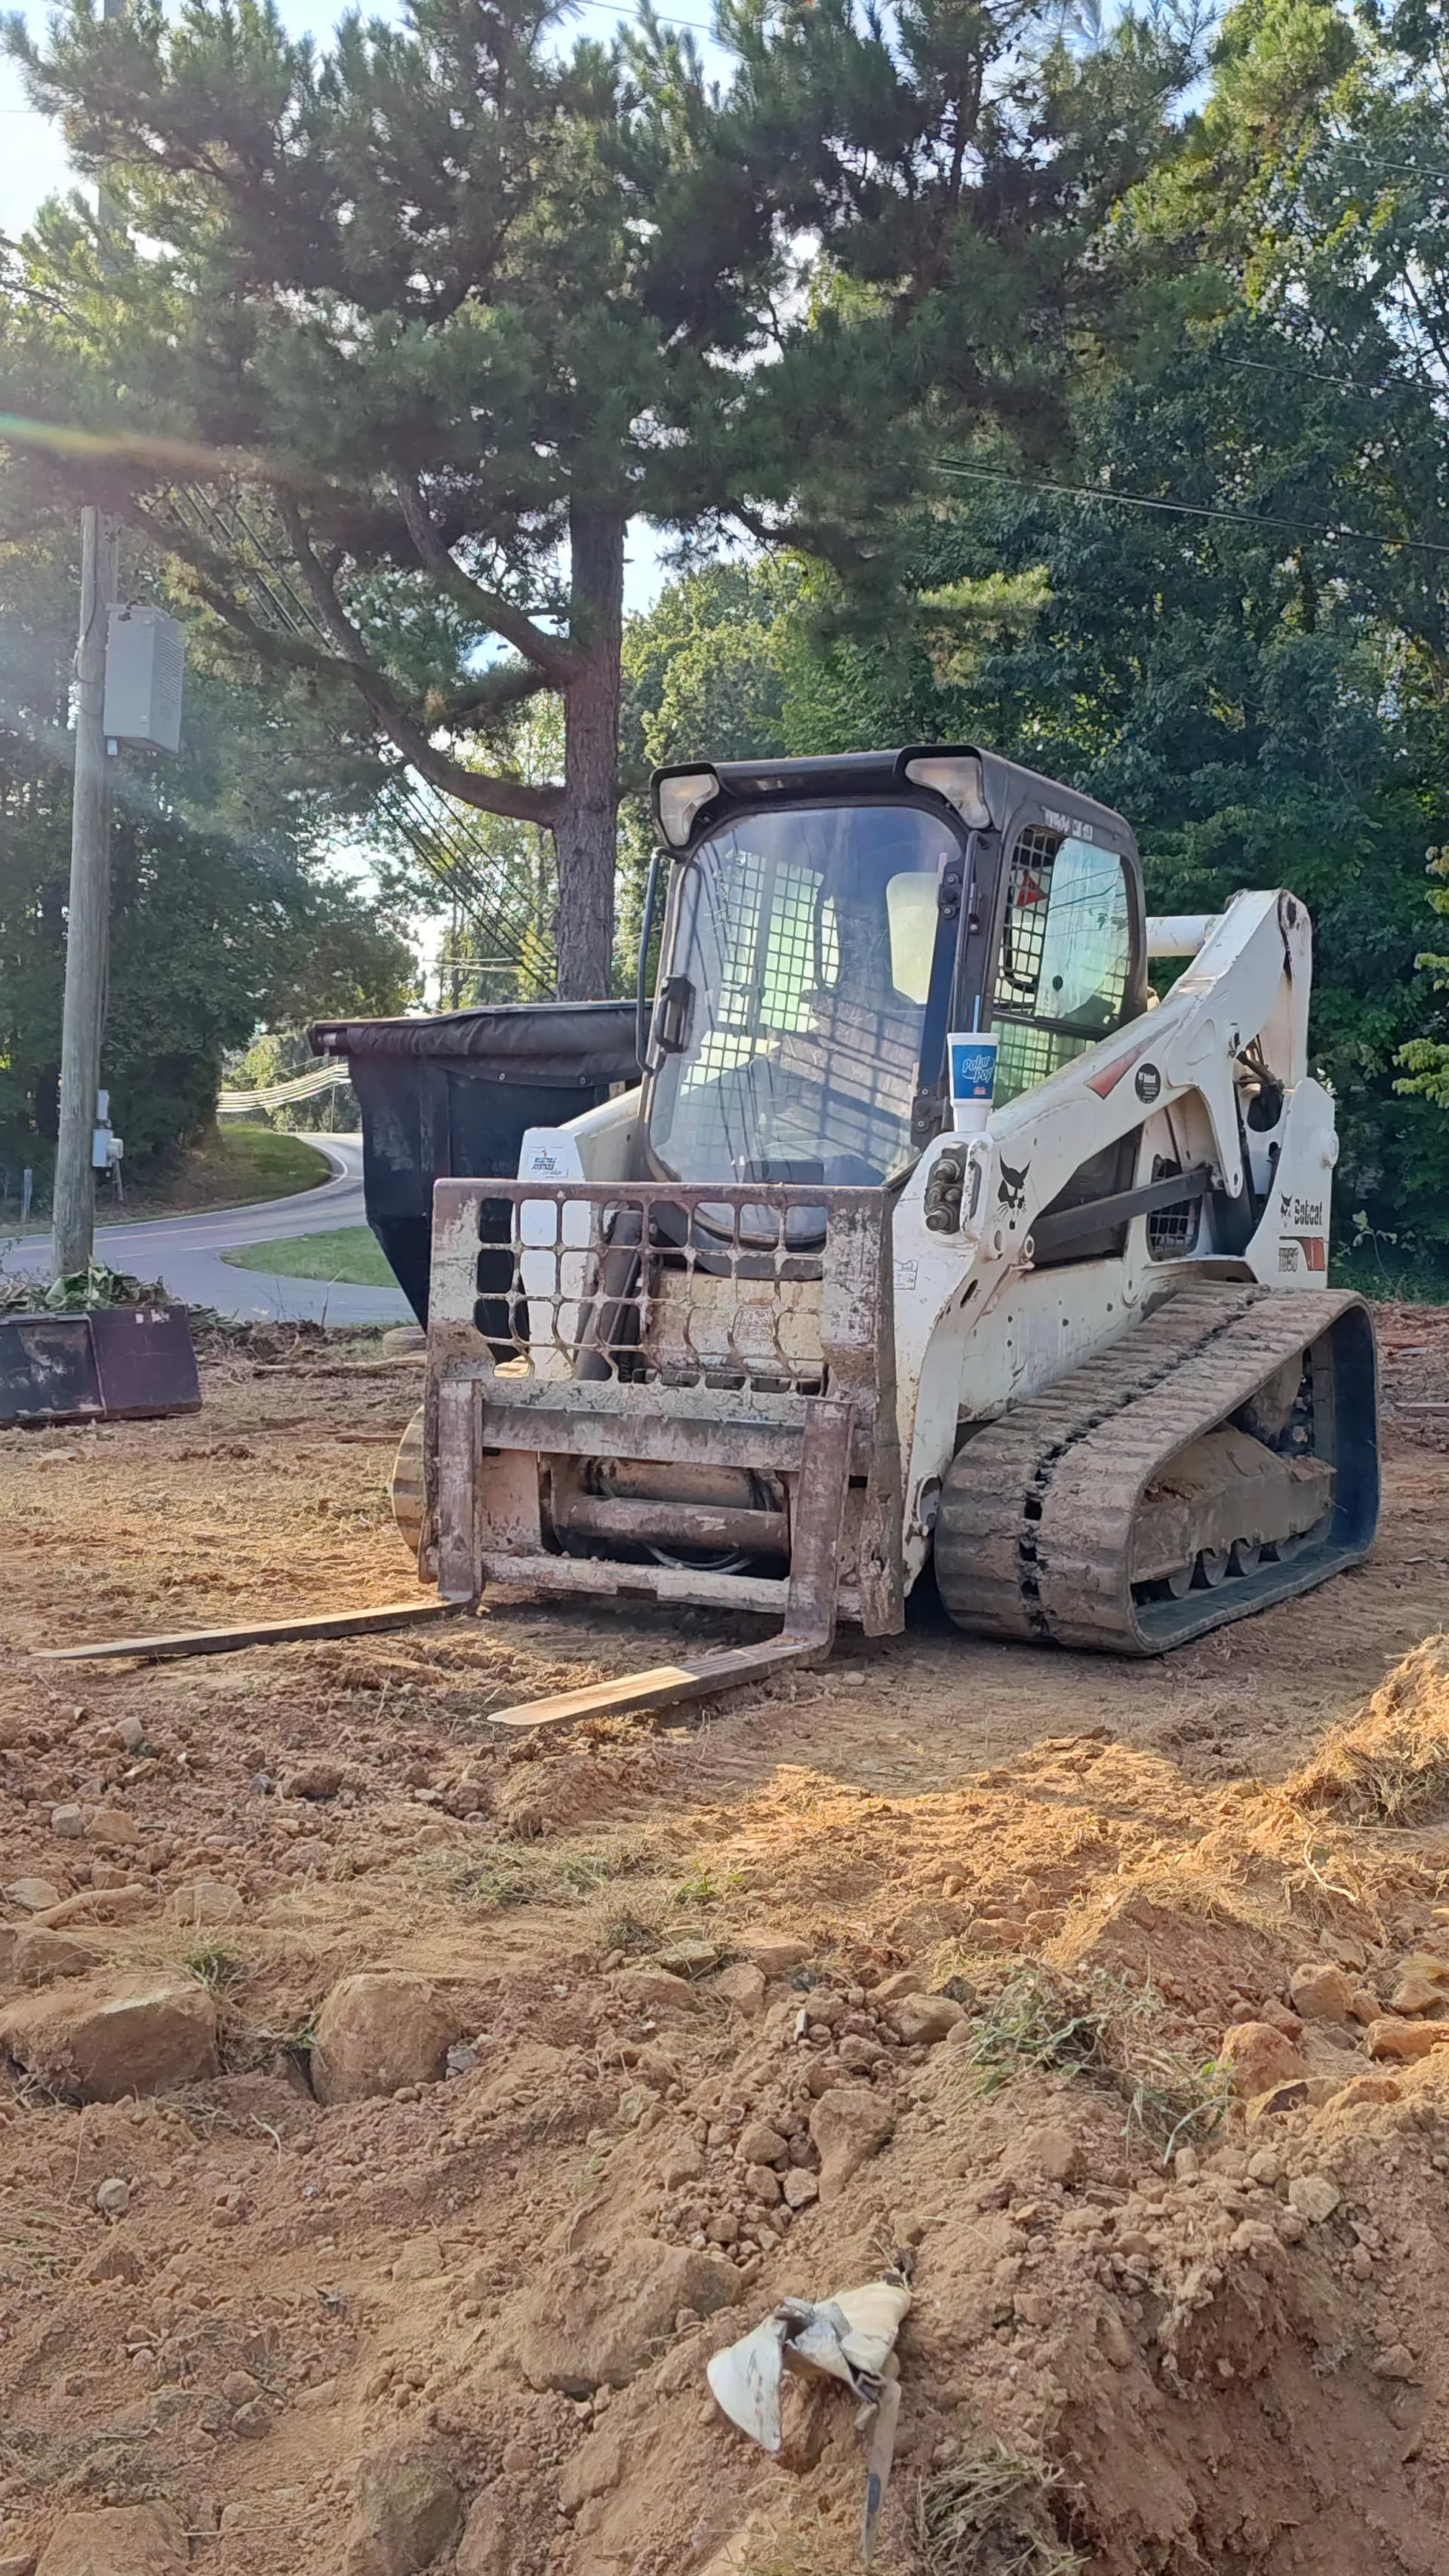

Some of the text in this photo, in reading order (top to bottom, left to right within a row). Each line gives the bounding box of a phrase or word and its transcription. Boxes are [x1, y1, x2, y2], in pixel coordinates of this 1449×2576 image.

[962, 1054, 990, 1073] Polar
[973, 1068, 992, 1083] Pop
[1294, 1199, 1323, 1226] Bobcat
